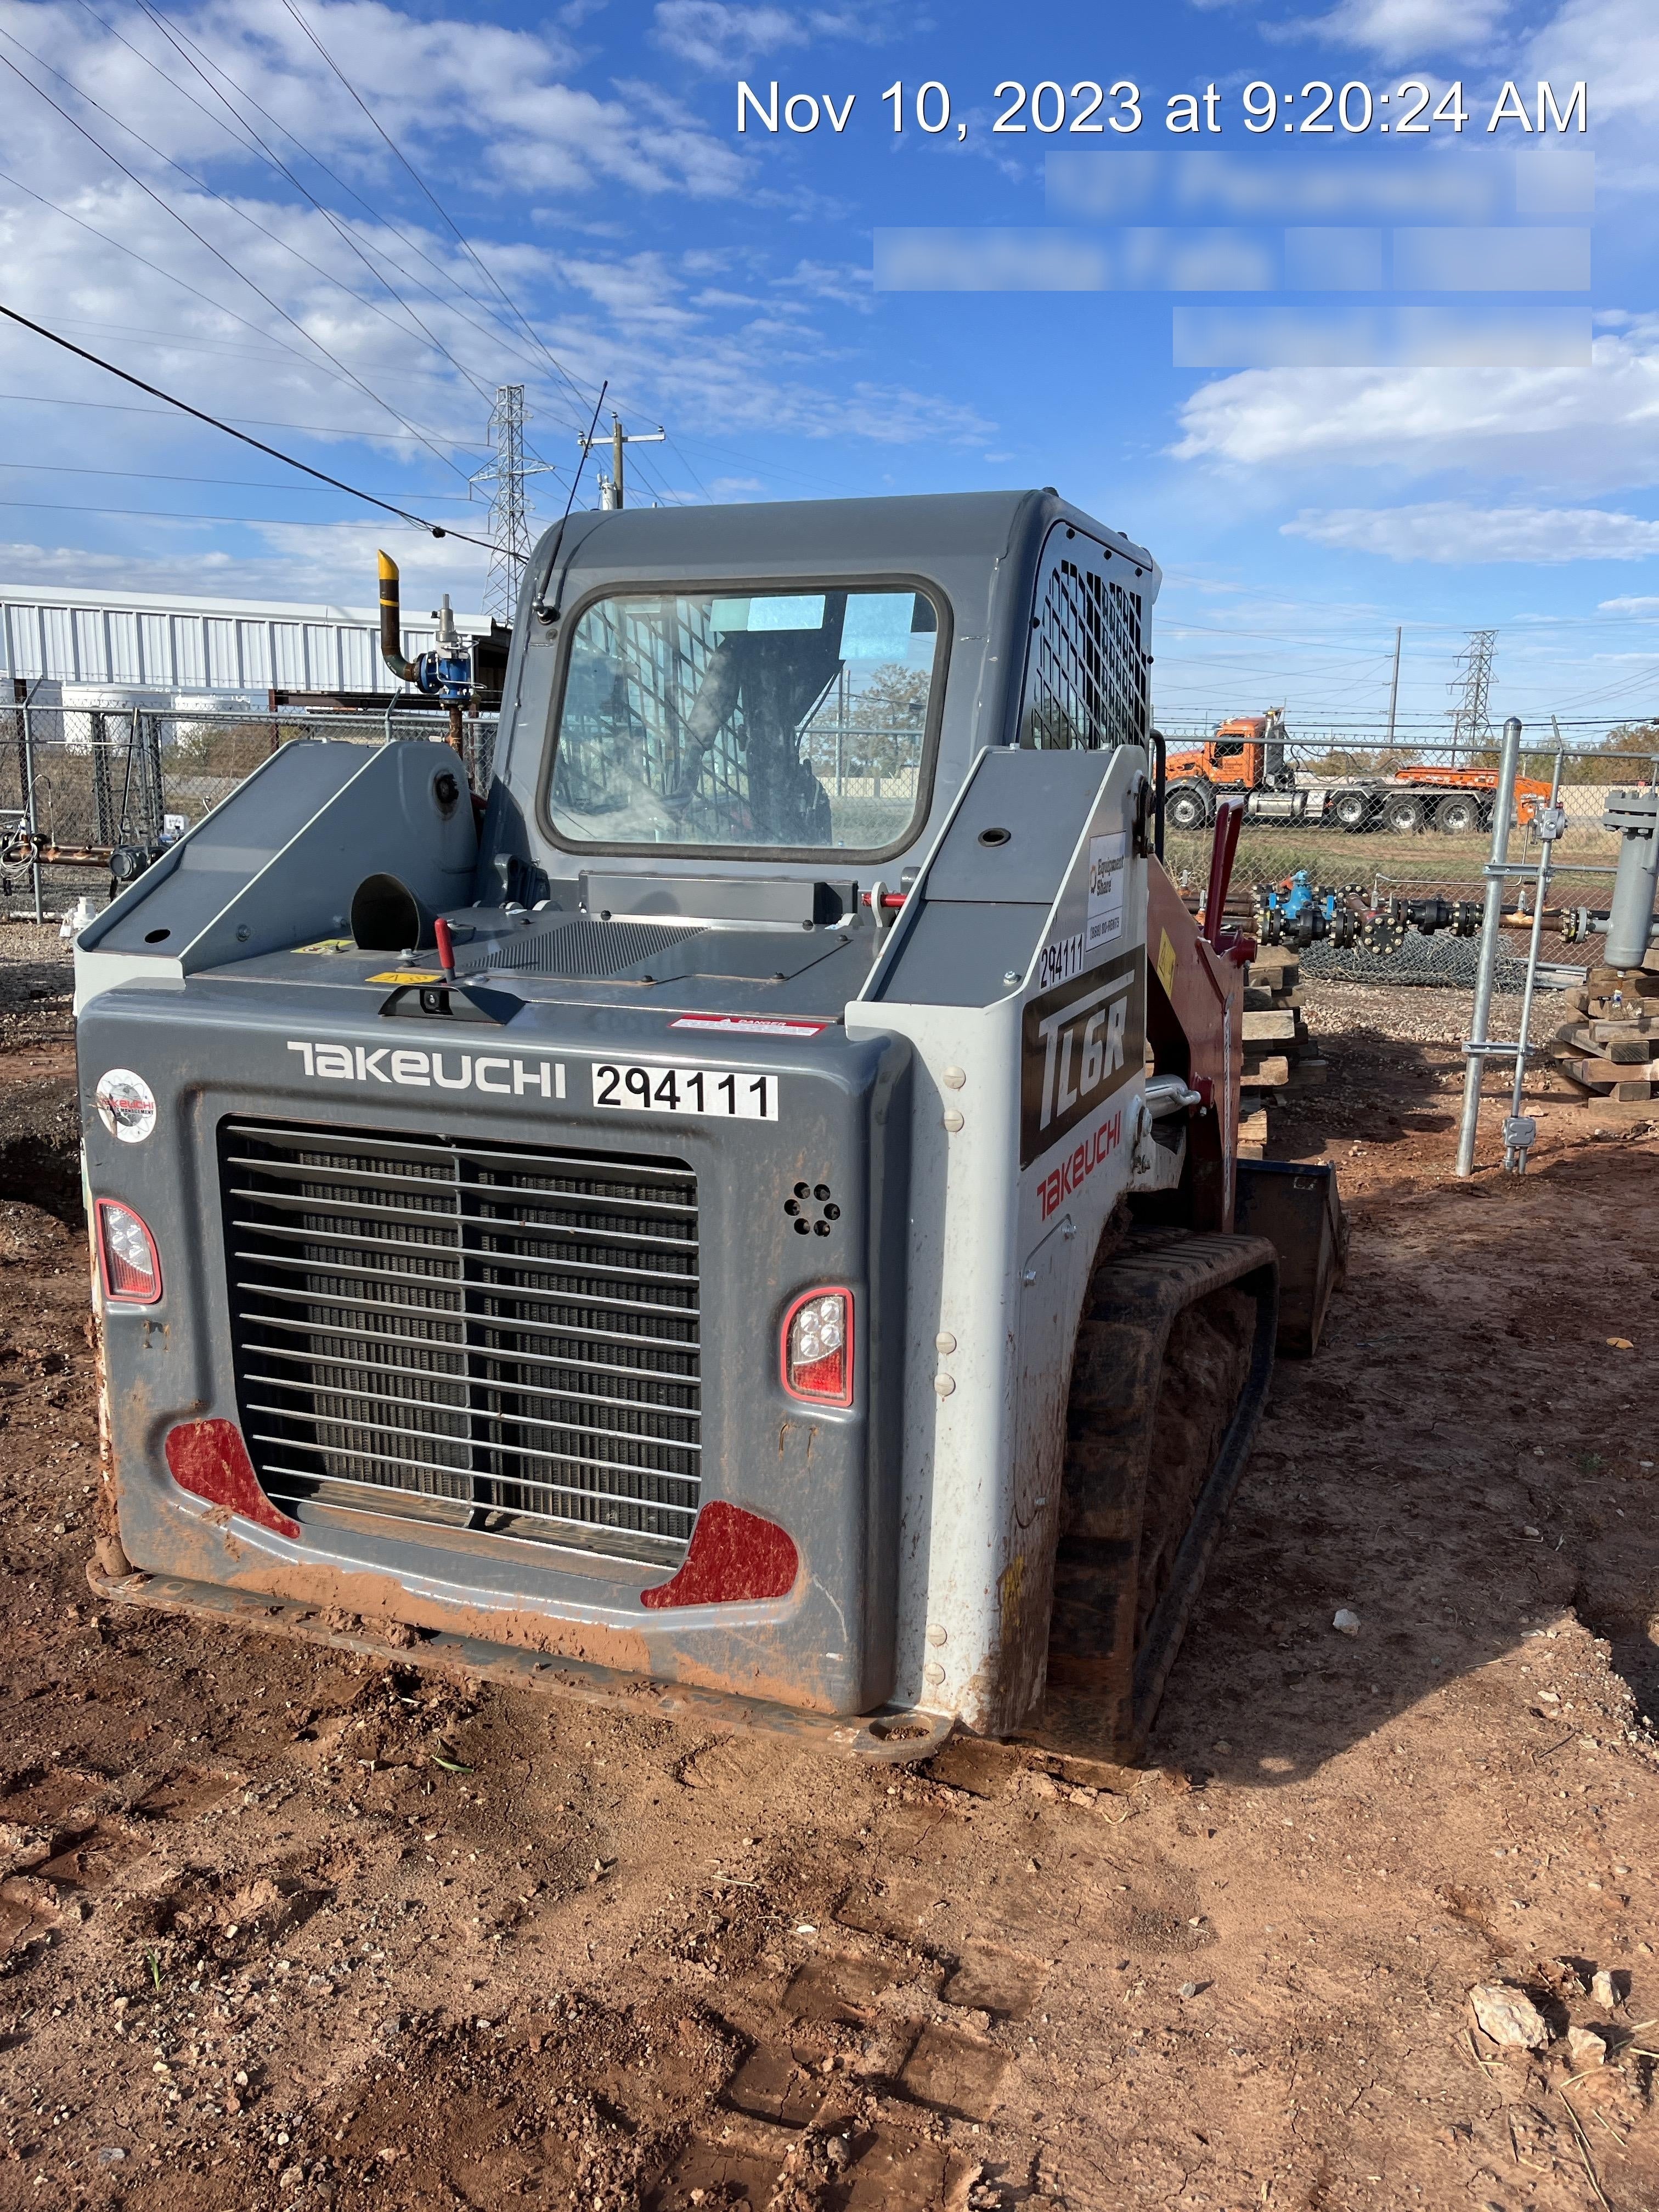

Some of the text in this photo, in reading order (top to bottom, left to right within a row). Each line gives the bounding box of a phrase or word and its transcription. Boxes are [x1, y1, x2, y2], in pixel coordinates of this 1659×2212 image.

[1097, 854, 1124, 878] Equipment
[1097, 879, 1111, 896] Share
[1040, 933, 1083, 989] 294111
[1038, 968, 1135, 1131] TL6R
[596, 1065, 768, 1118] 294111
